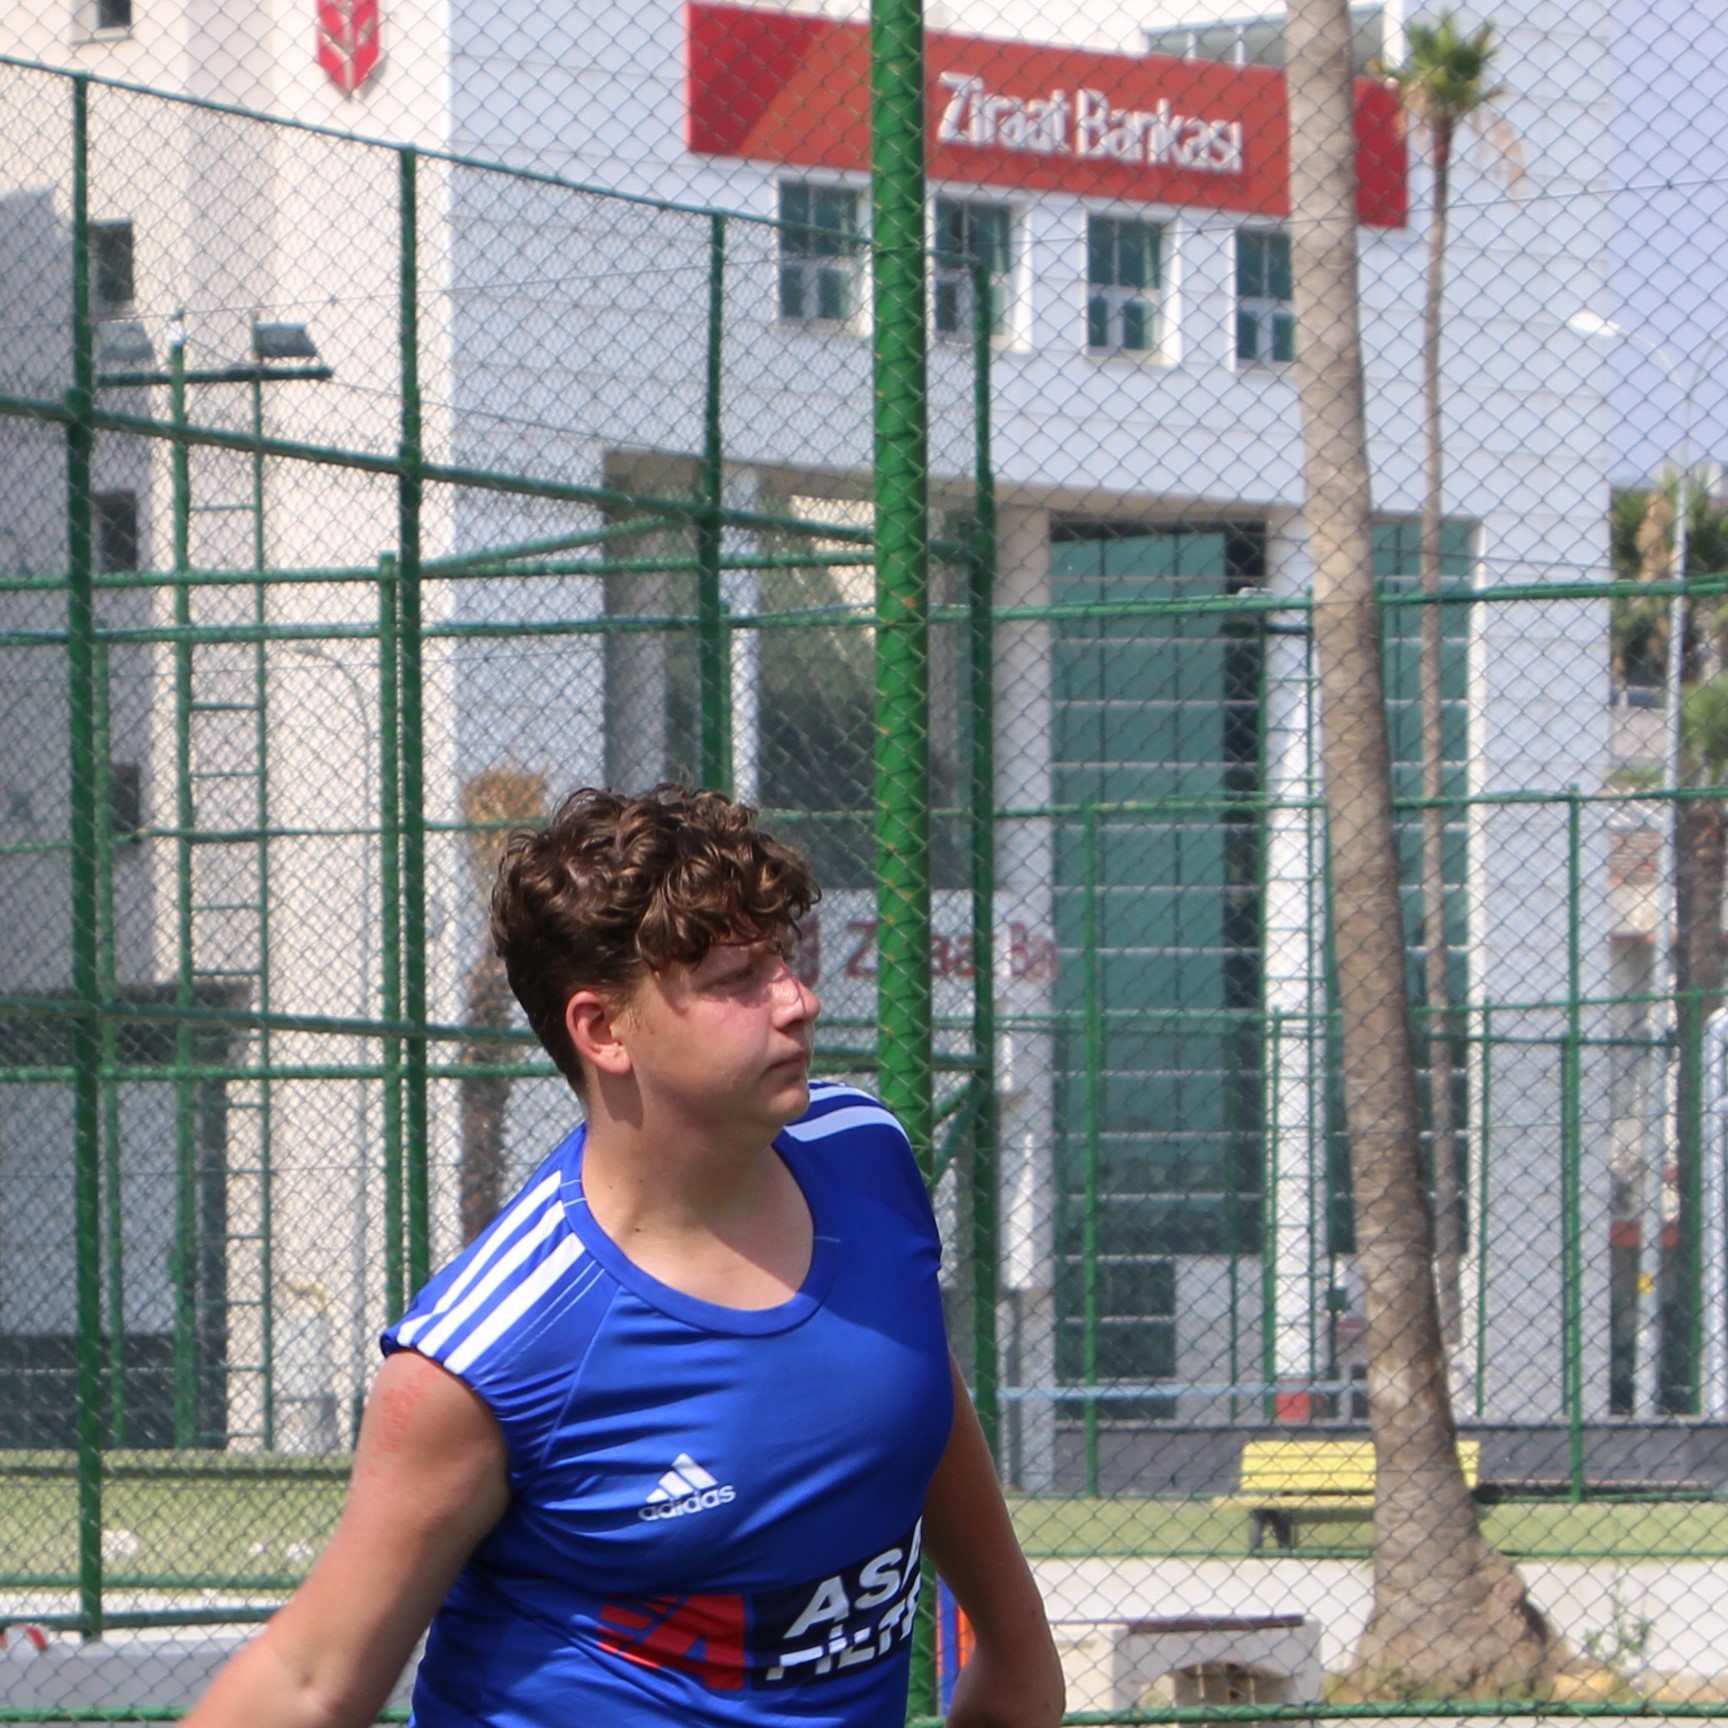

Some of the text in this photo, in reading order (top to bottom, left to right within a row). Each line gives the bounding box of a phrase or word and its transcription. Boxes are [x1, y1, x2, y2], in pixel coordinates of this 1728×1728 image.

[937, 71, 1242, 174] Ziraat Bankası
[638, 1484, 736, 1521] adidas
